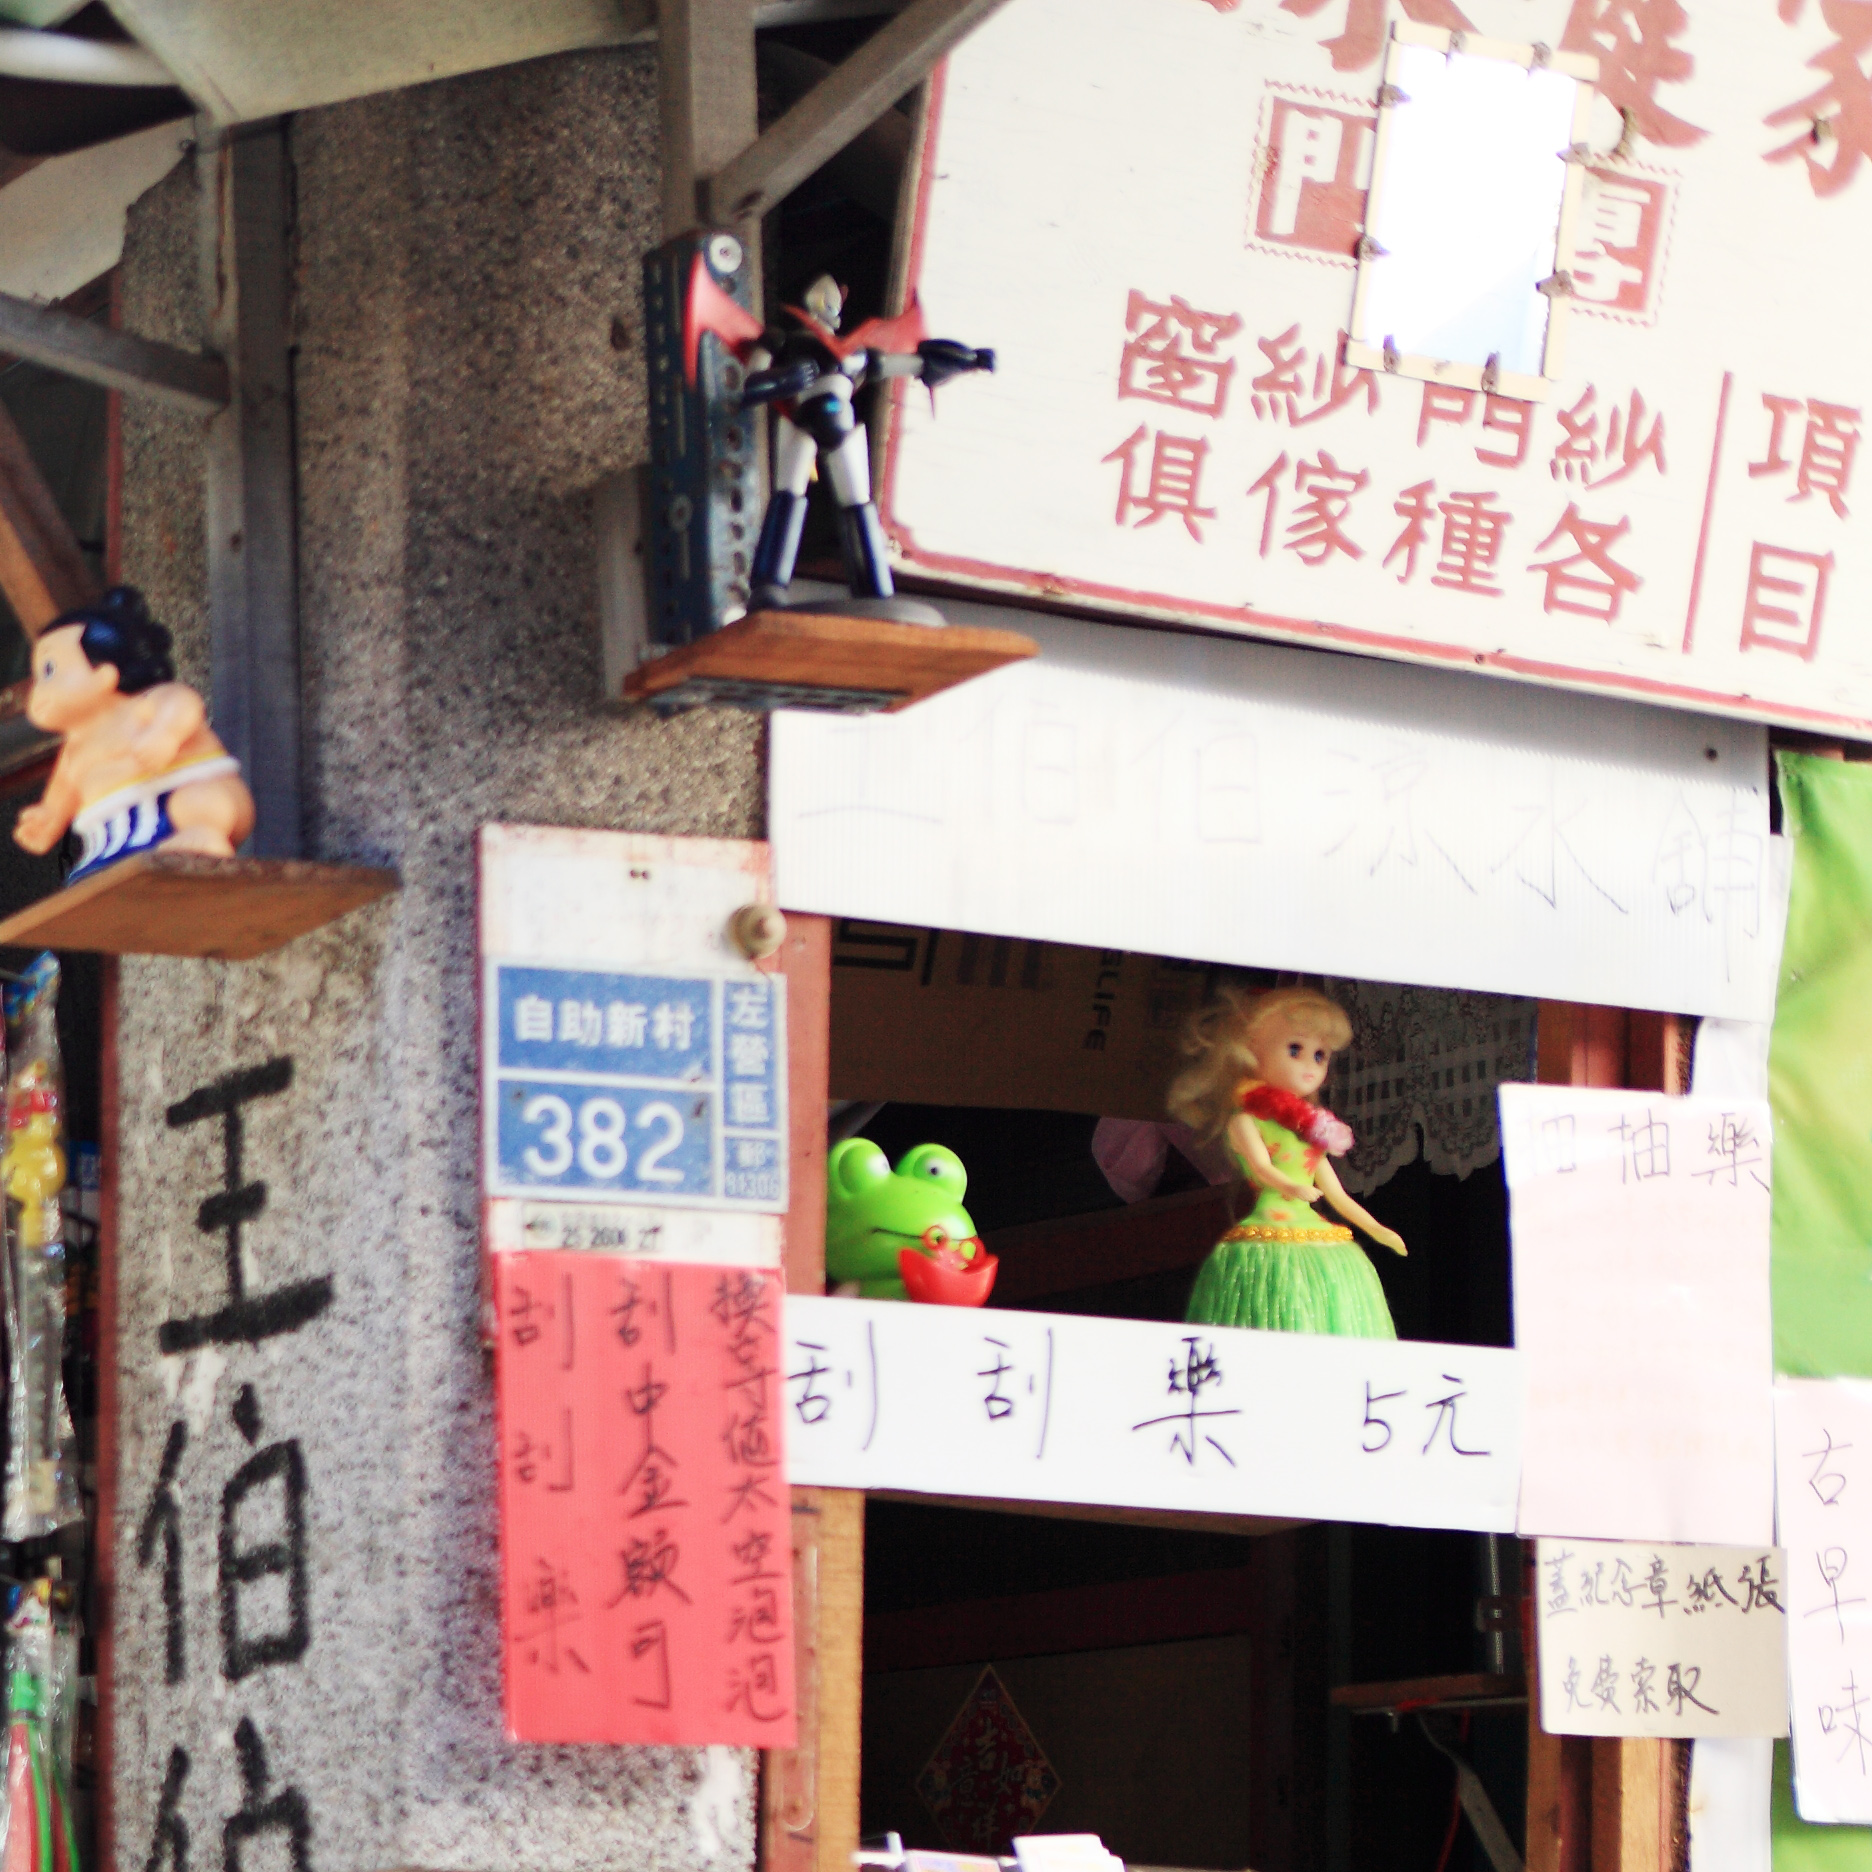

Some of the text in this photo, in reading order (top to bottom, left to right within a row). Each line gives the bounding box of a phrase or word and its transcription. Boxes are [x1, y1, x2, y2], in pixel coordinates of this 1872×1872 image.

[513, 992, 696, 1051] 自助新村
[729, 986, 771, 1125] 左營區
[522, 1094, 686, 1184] 382
[1359, 1373, 1493, 1461] 5元
[1802, 1427, 1872, 1777] 古早味
